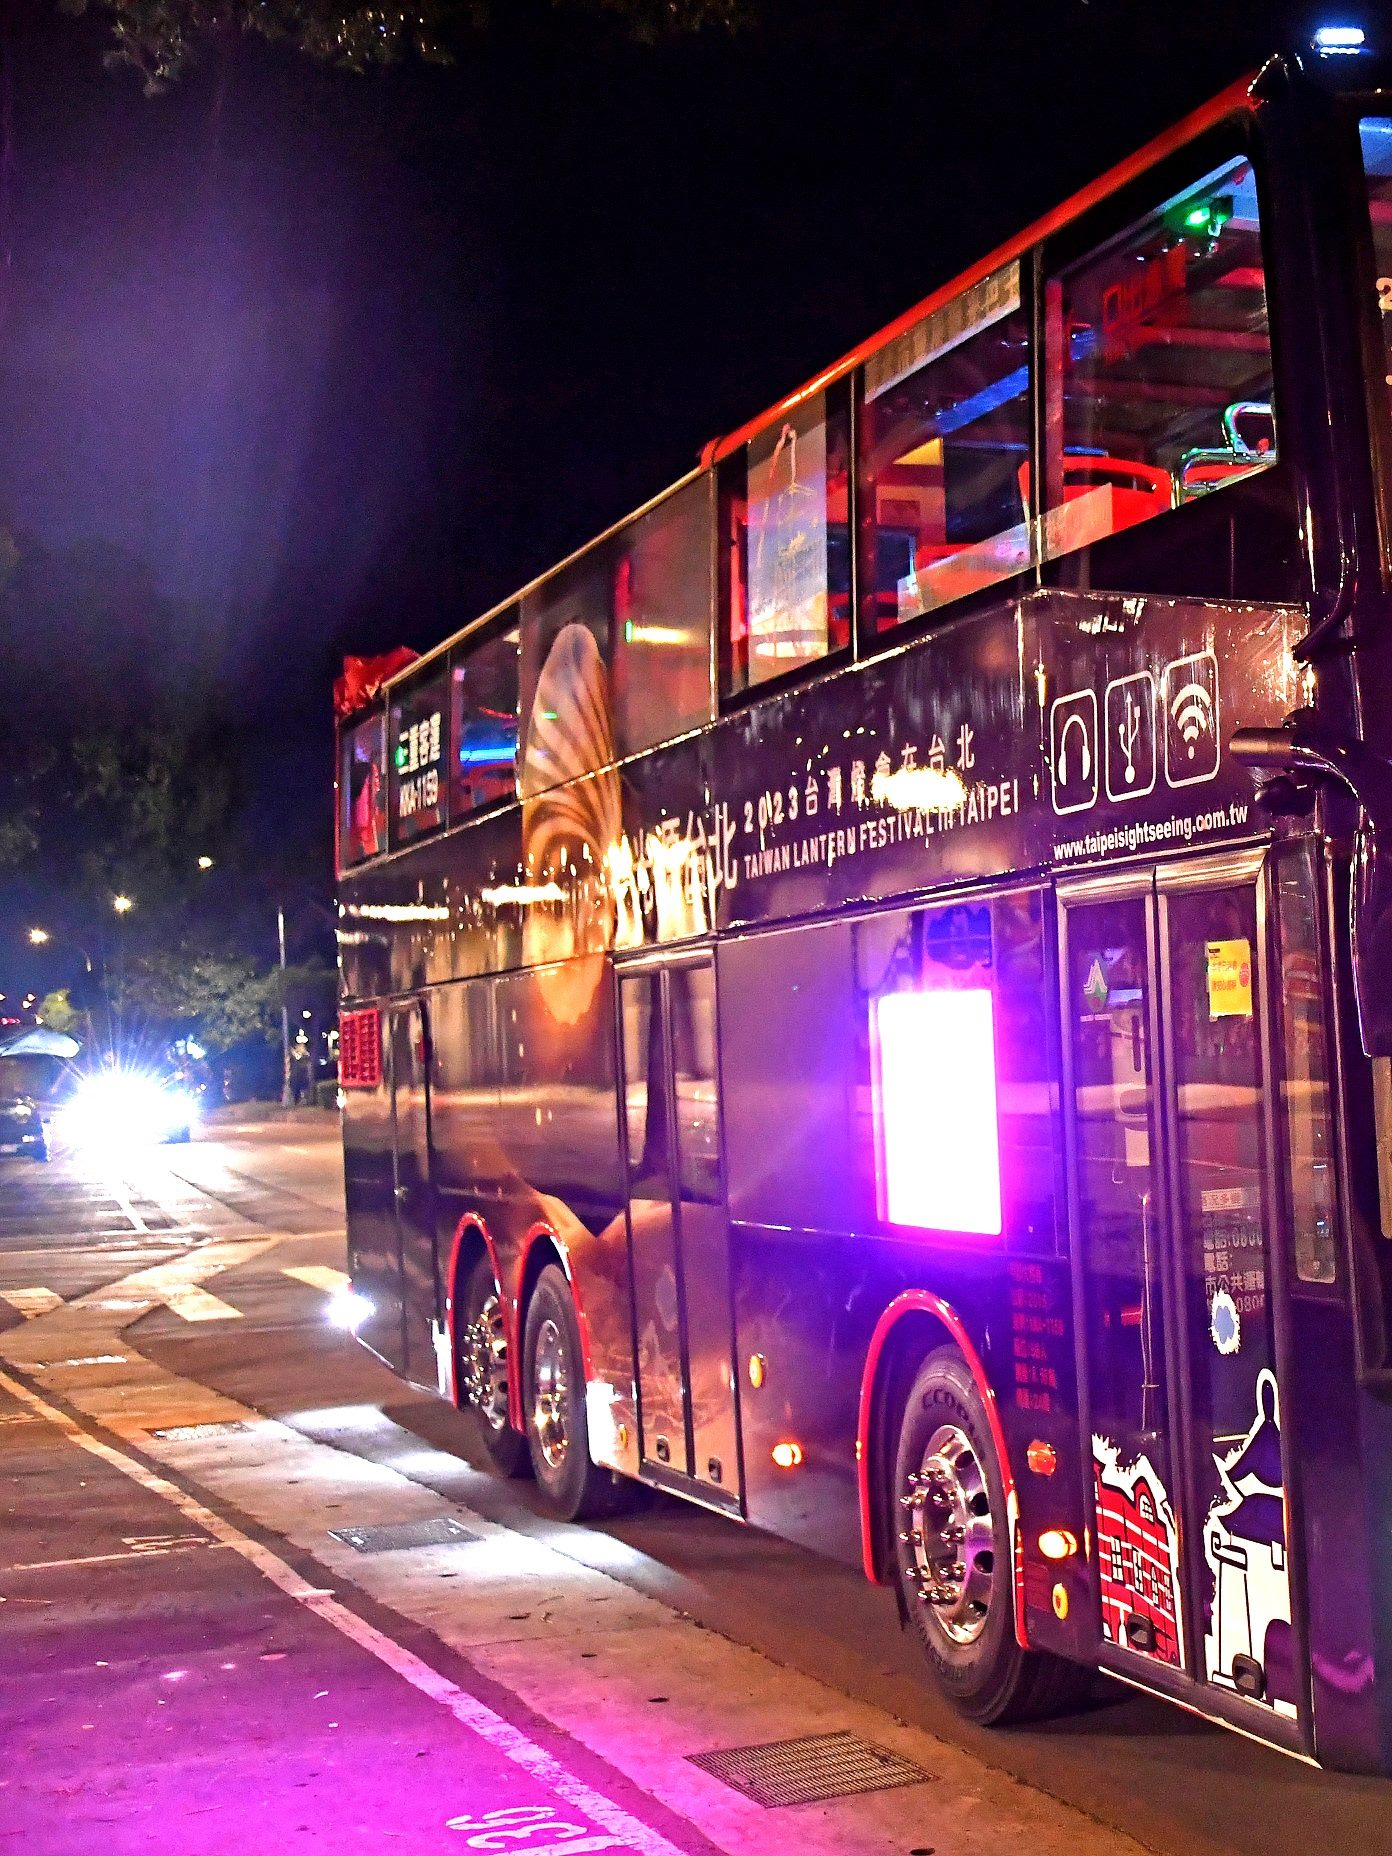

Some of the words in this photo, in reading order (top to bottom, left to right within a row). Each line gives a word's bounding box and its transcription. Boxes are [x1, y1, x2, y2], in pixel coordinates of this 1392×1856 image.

[744, 845, 790, 880] TAIWAN
[793, 827, 856, 868] LANTERN
[860, 808, 934, 851] FESTIVAL
[960, 778, 1018, 827] TAIPEI
[1053, 803, 1248, 860] www.taipeisightseeing.com.tw
